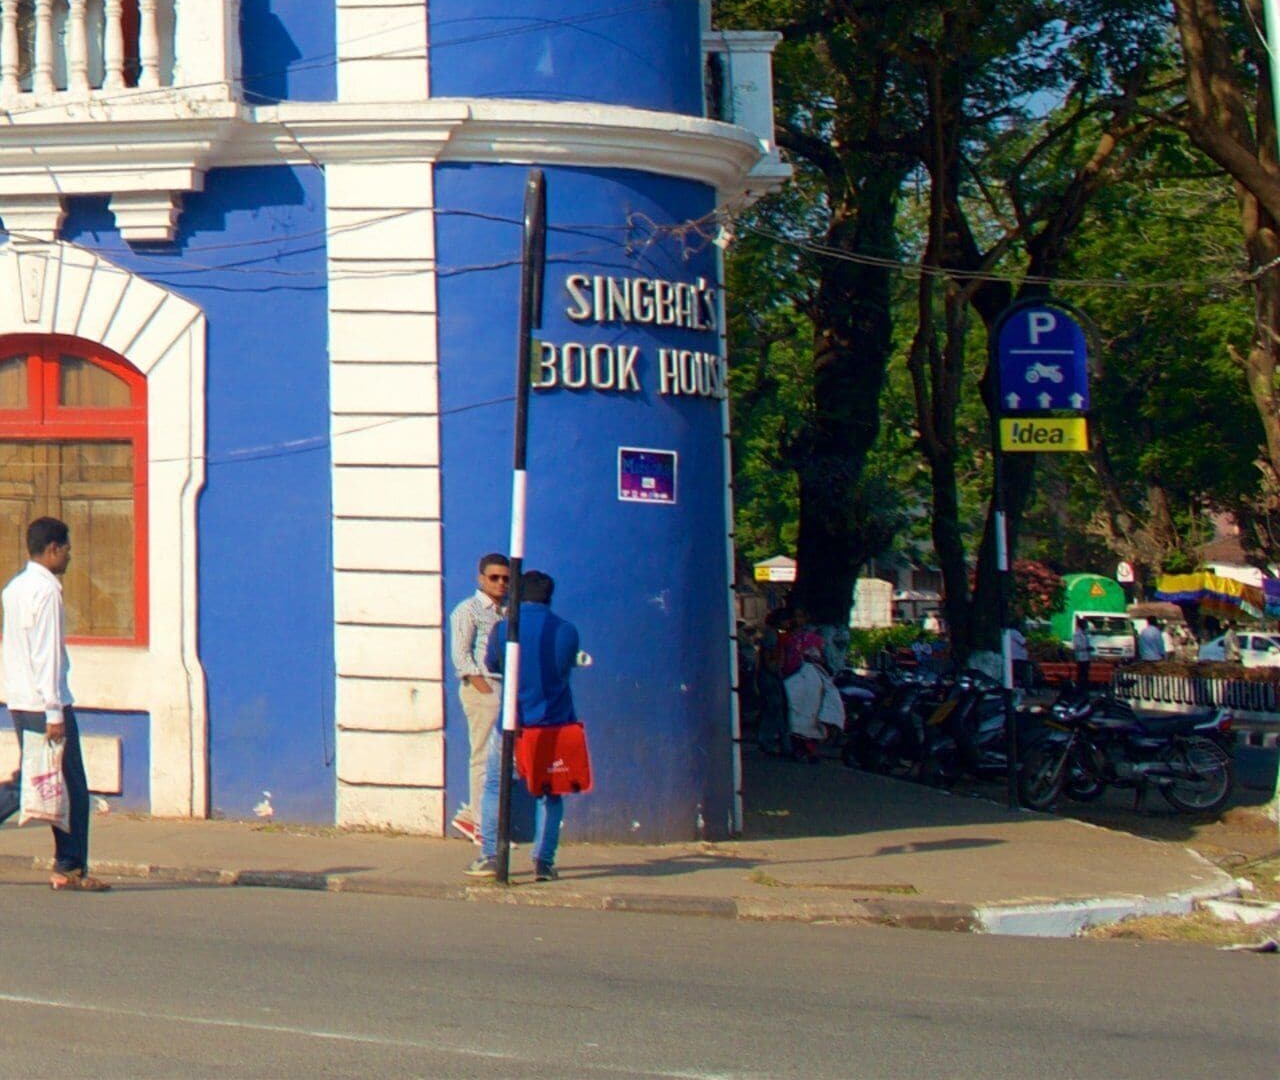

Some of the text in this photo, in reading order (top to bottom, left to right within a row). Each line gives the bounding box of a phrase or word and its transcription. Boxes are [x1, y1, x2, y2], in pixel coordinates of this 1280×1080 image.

[565, 273, 717, 332] SINGBAL'S
[1028, 311, 1057, 345] P
[531, 340, 640, 392] BOOK
